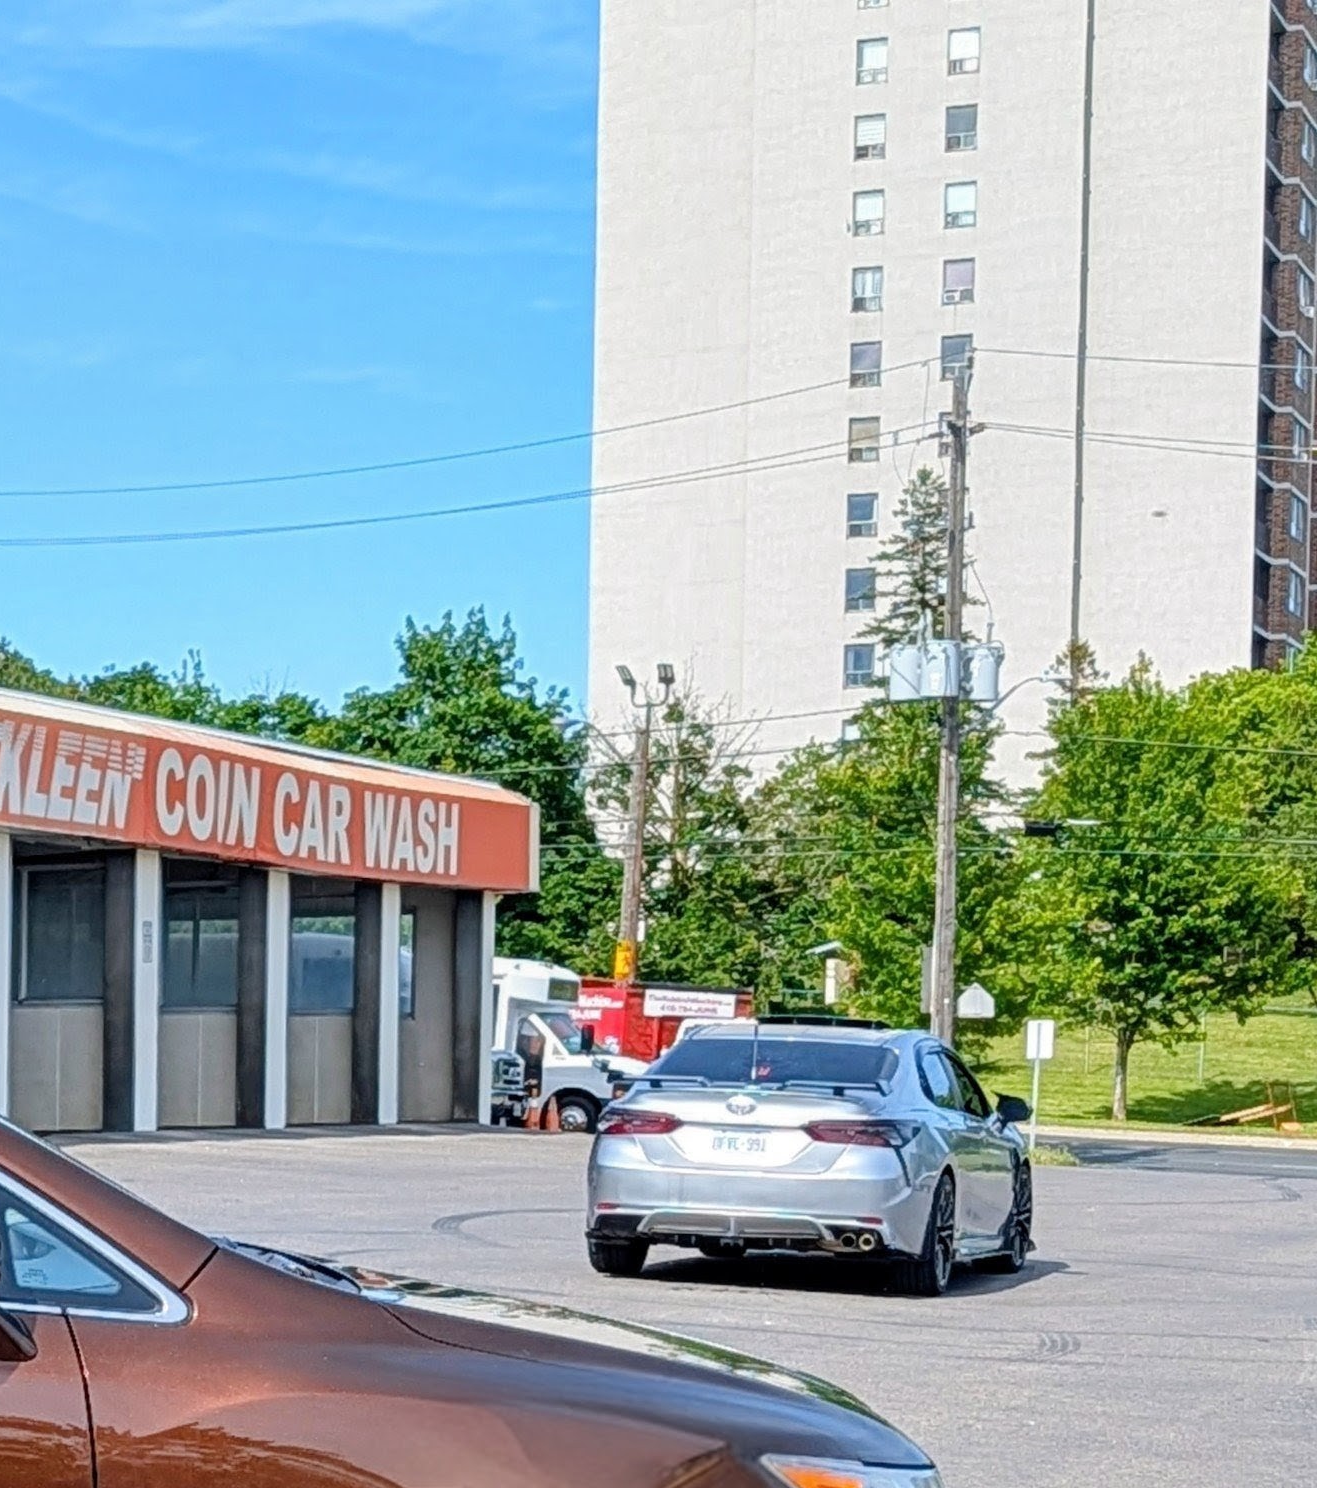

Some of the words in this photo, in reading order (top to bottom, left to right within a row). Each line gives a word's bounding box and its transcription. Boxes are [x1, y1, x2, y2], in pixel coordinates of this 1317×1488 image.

[155, 747, 261, 849] COIN
[273, 771, 352, 866] CAR
[363, 790, 460, 877] WASH
